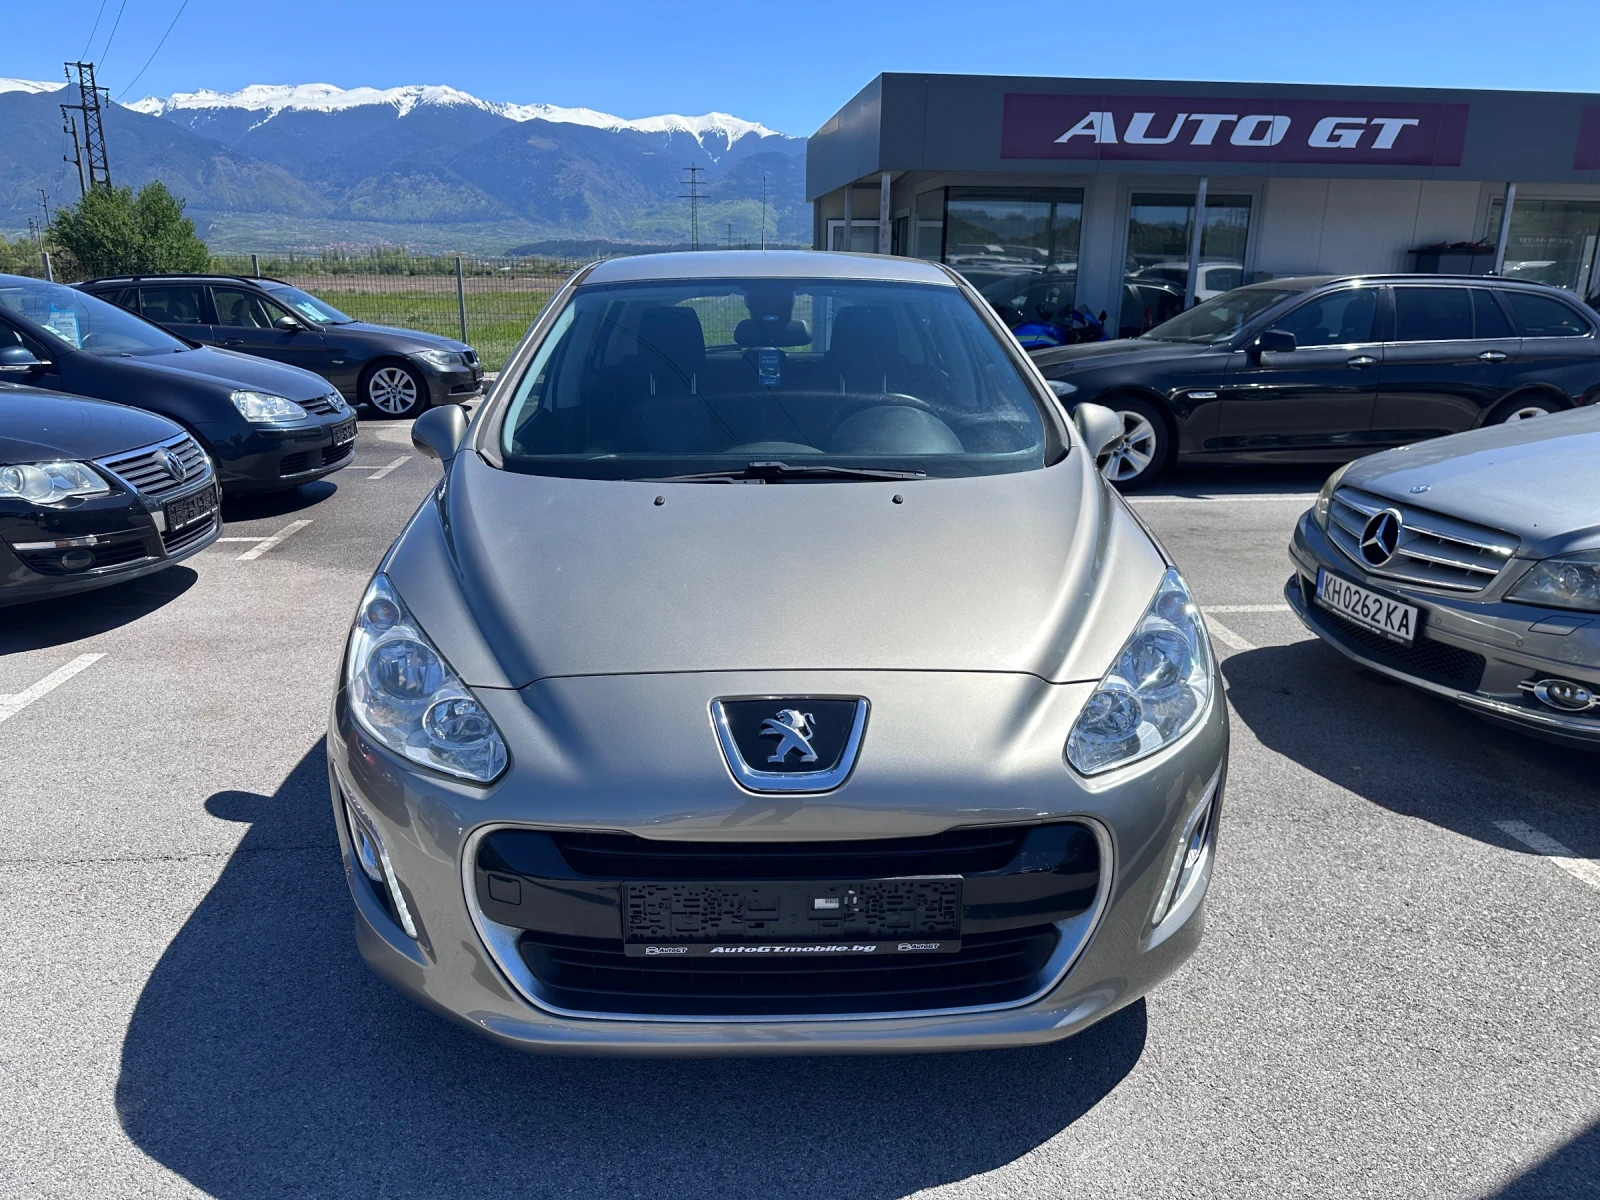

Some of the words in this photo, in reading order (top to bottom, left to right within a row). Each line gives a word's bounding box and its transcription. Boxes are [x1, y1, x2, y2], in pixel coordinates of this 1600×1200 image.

[1054, 112, 1292, 146] AUTO
[1308, 117, 1420, 149] GT
[1324, 575, 1410, 635] KH0262KA
